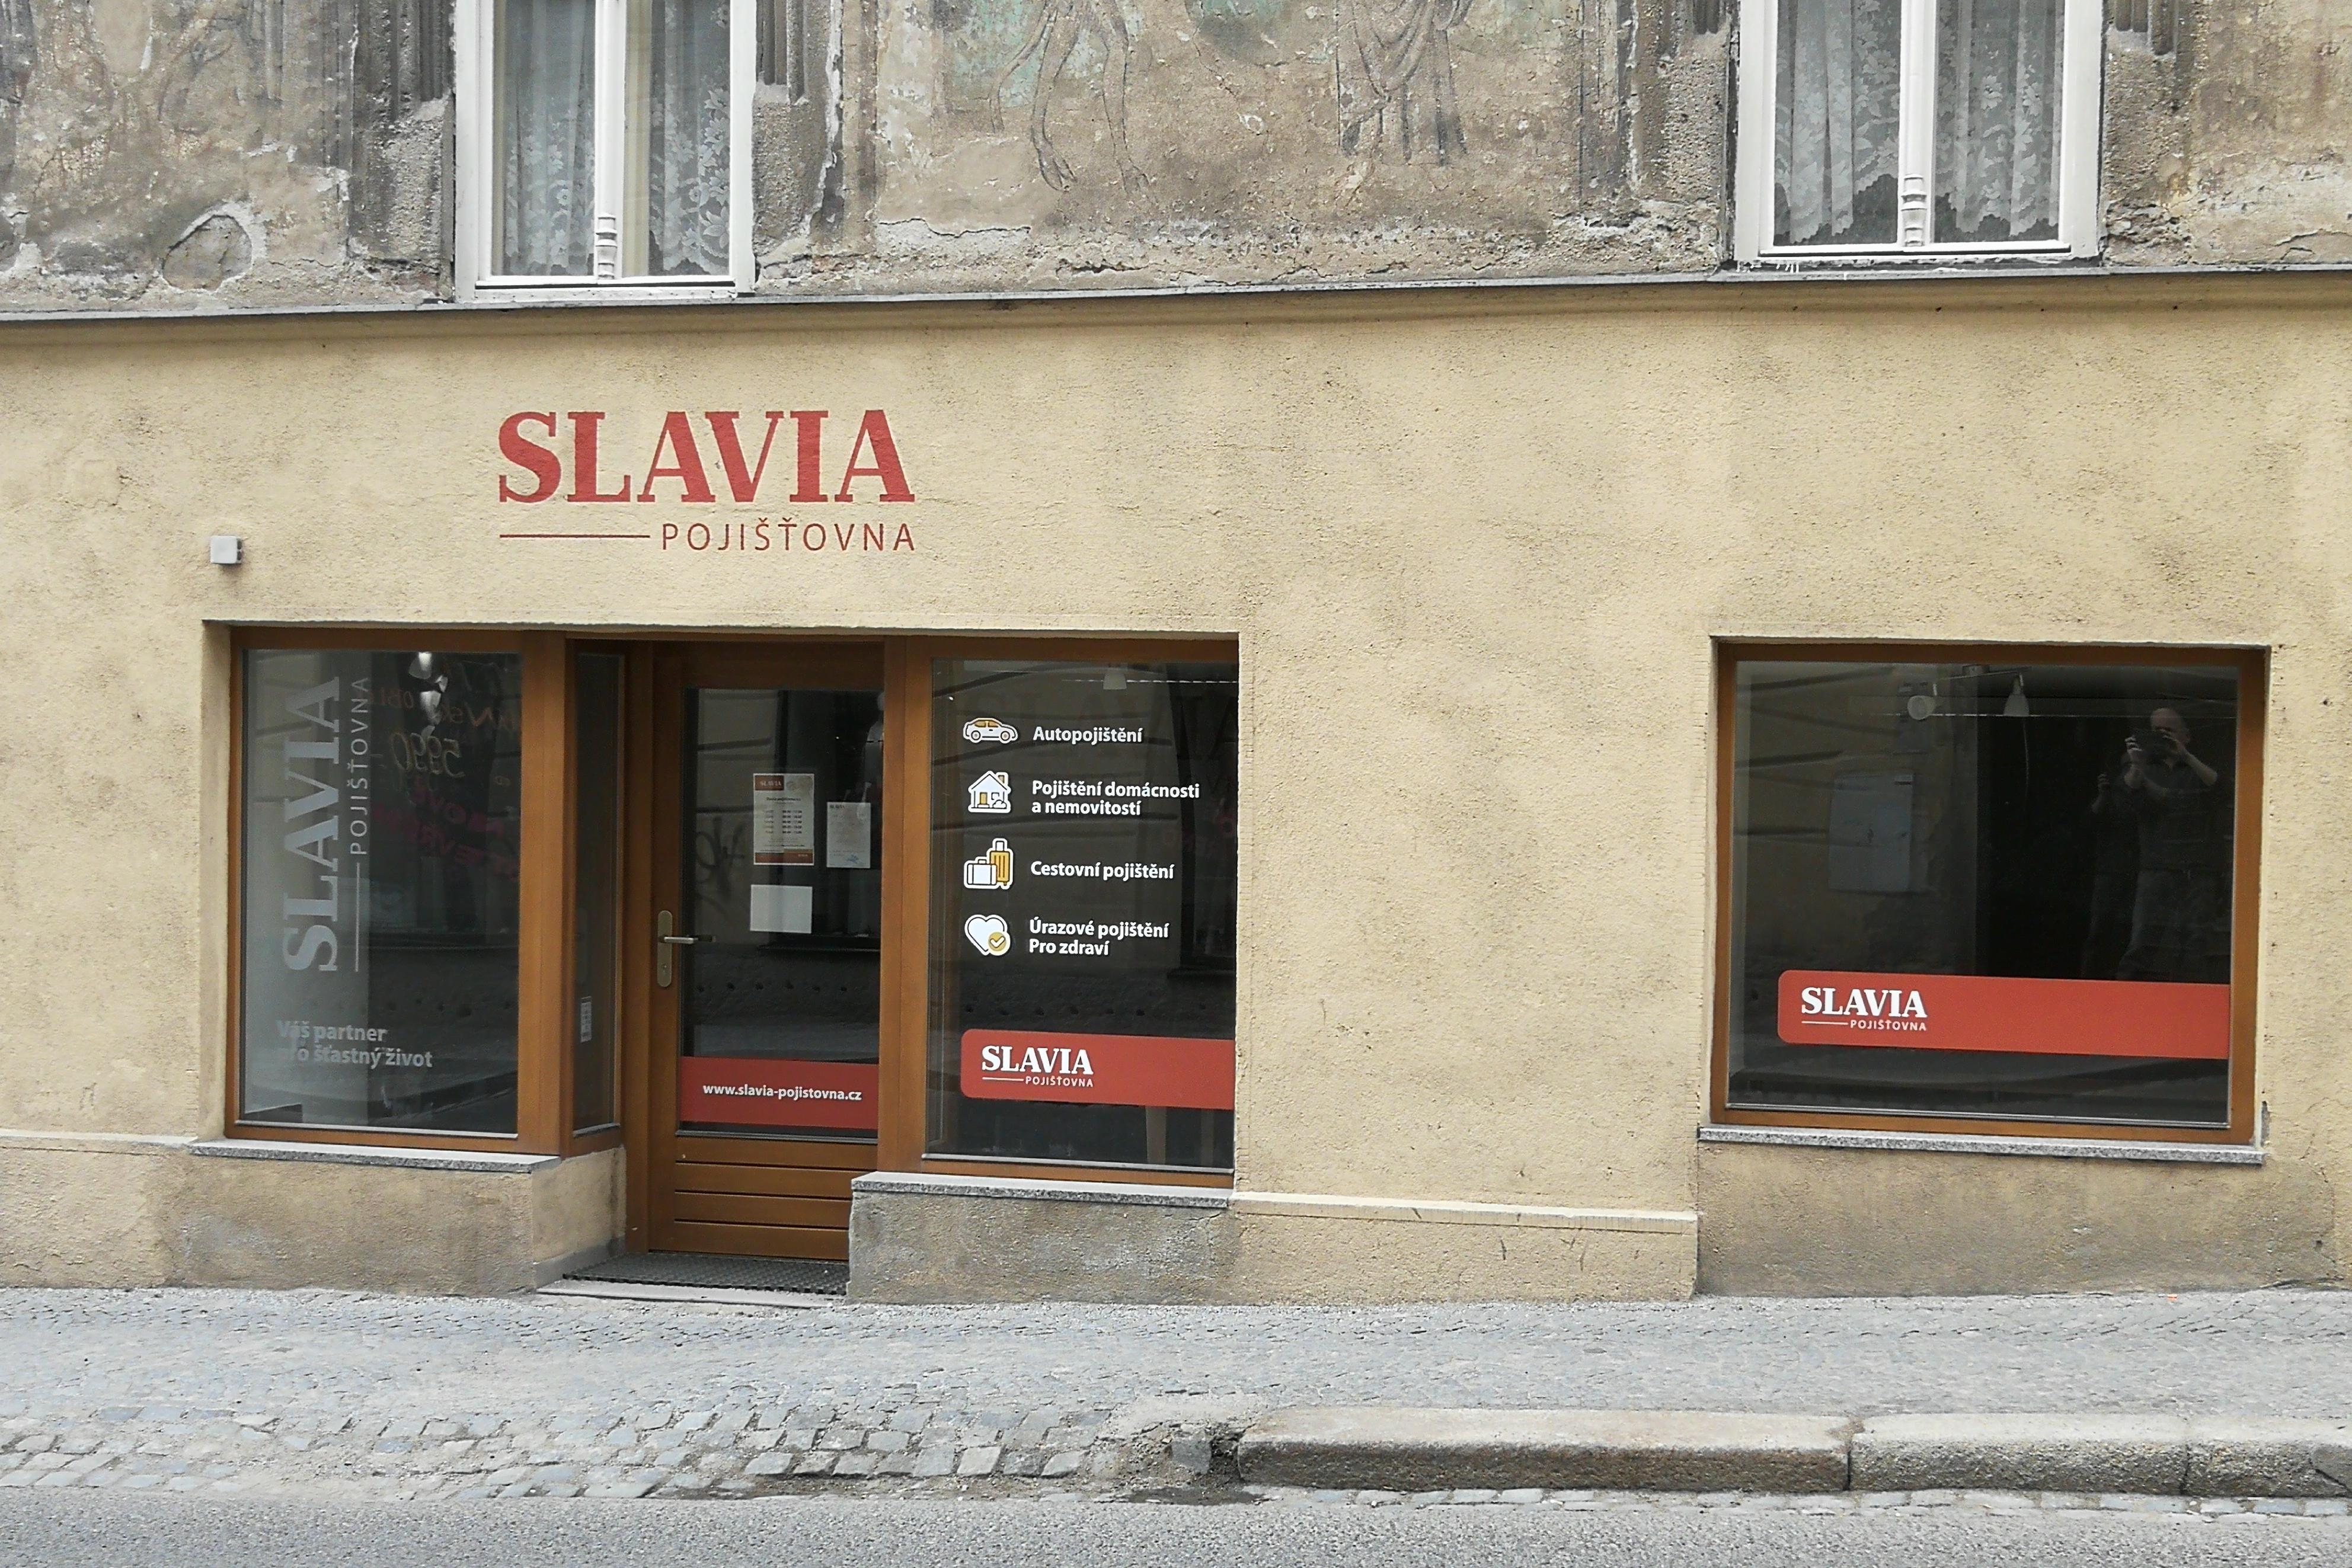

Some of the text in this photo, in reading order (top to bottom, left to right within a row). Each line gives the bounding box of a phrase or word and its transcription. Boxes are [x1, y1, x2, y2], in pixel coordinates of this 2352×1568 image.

[498, 409, 915, 503] SLAVIA
[662, 517, 915, 551] POJIŠŤOVNA
[1033, 726, 1143, 745] Autopojištění
[346, 677, 369, 856] POJIŠŤOVNA
[1032, 780, 1200, 798] Pojištění domácnosti
[1031, 800, 1140, 815] a nemovitostí
[282, 677, 340, 972] SLAVIA
[1031, 860, 1175, 881] Cestovní pojištění
[1030, 916, 1169, 940] Úrazové pojištění
[1030, 939, 1110, 955] Pro zdraví
[1801, 987, 1928, 1018] SLAVIA
[313, 1025, 388, 1044] partner
[1850, 1019, 1927, 1031] POJIŠŤOVNA
[314, 1044, 382, 1070] šťastný
[385, 1047, 433, 1067] život
[982, 1045, 1094, 1075] SLAVIA
[1025, 1076, 1094, 1087] POJIŠŤOVNA
[703, 1084, 862, 1101] www.slavia-pojistovna.cz
